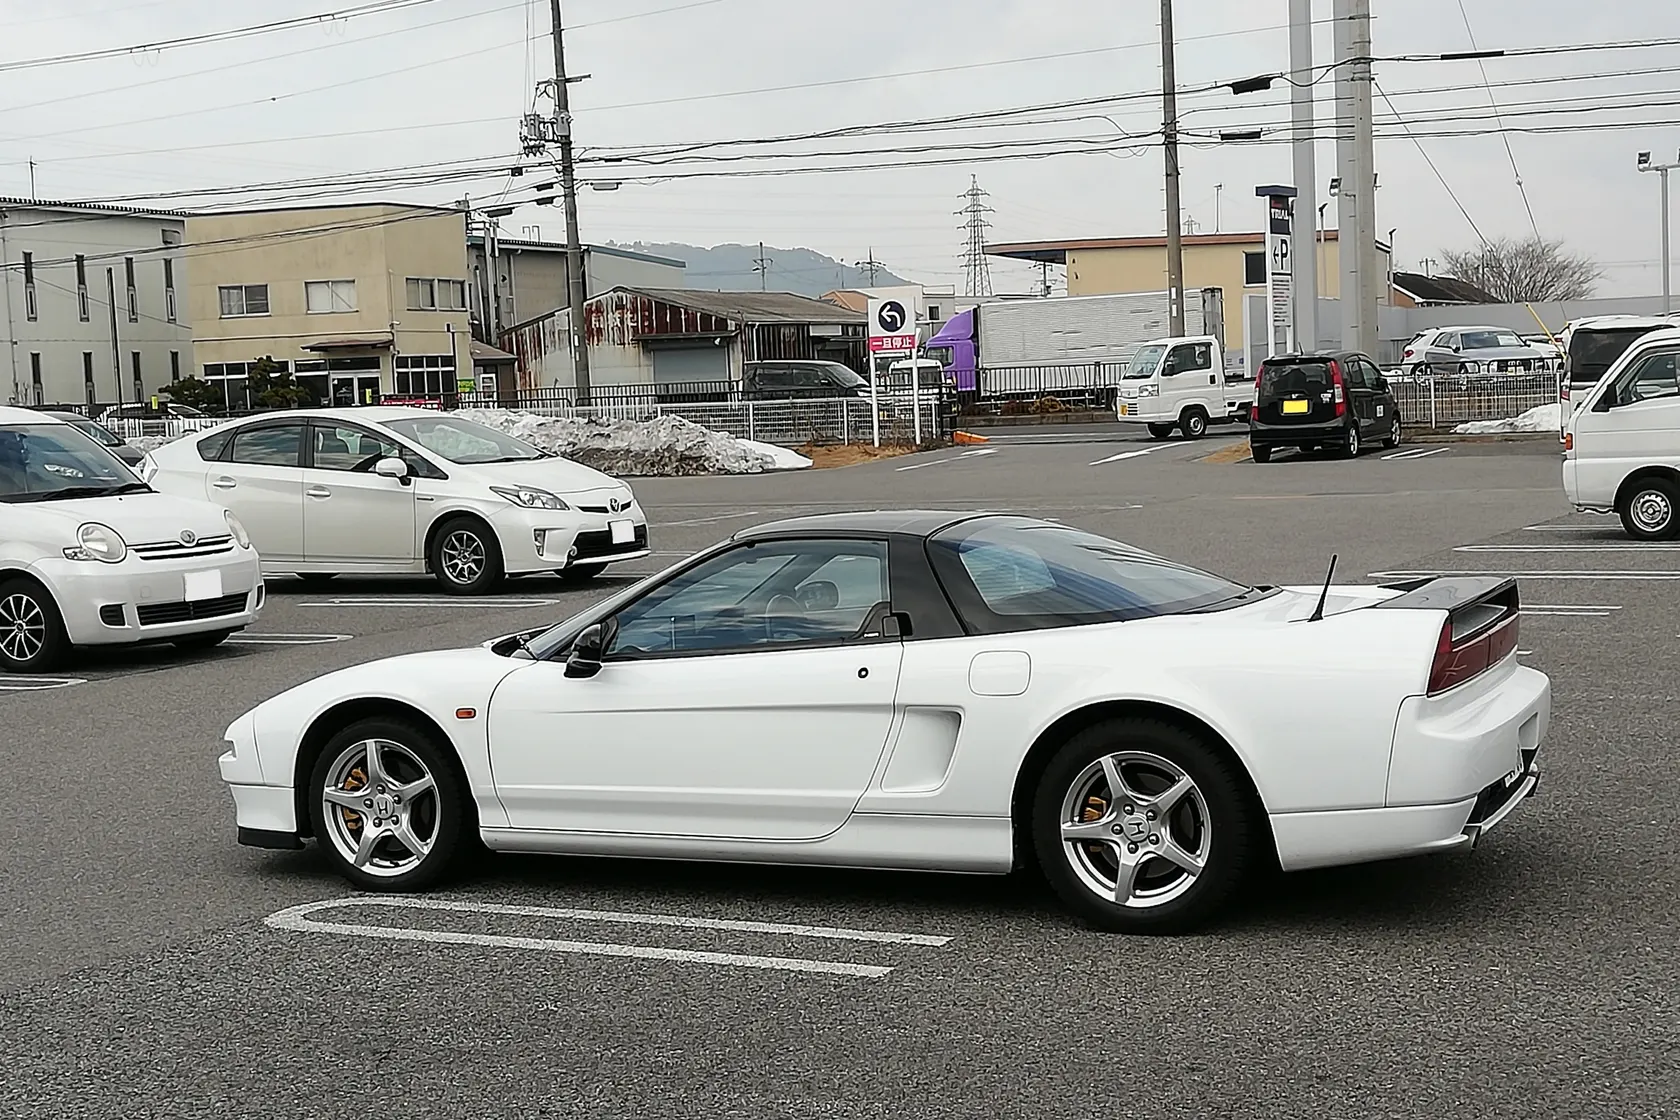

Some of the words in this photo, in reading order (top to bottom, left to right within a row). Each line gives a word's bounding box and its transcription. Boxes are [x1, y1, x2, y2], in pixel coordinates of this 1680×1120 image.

[1280, 238, 1289, 271] P
[872, 336, 913, 348] 一旦停止
